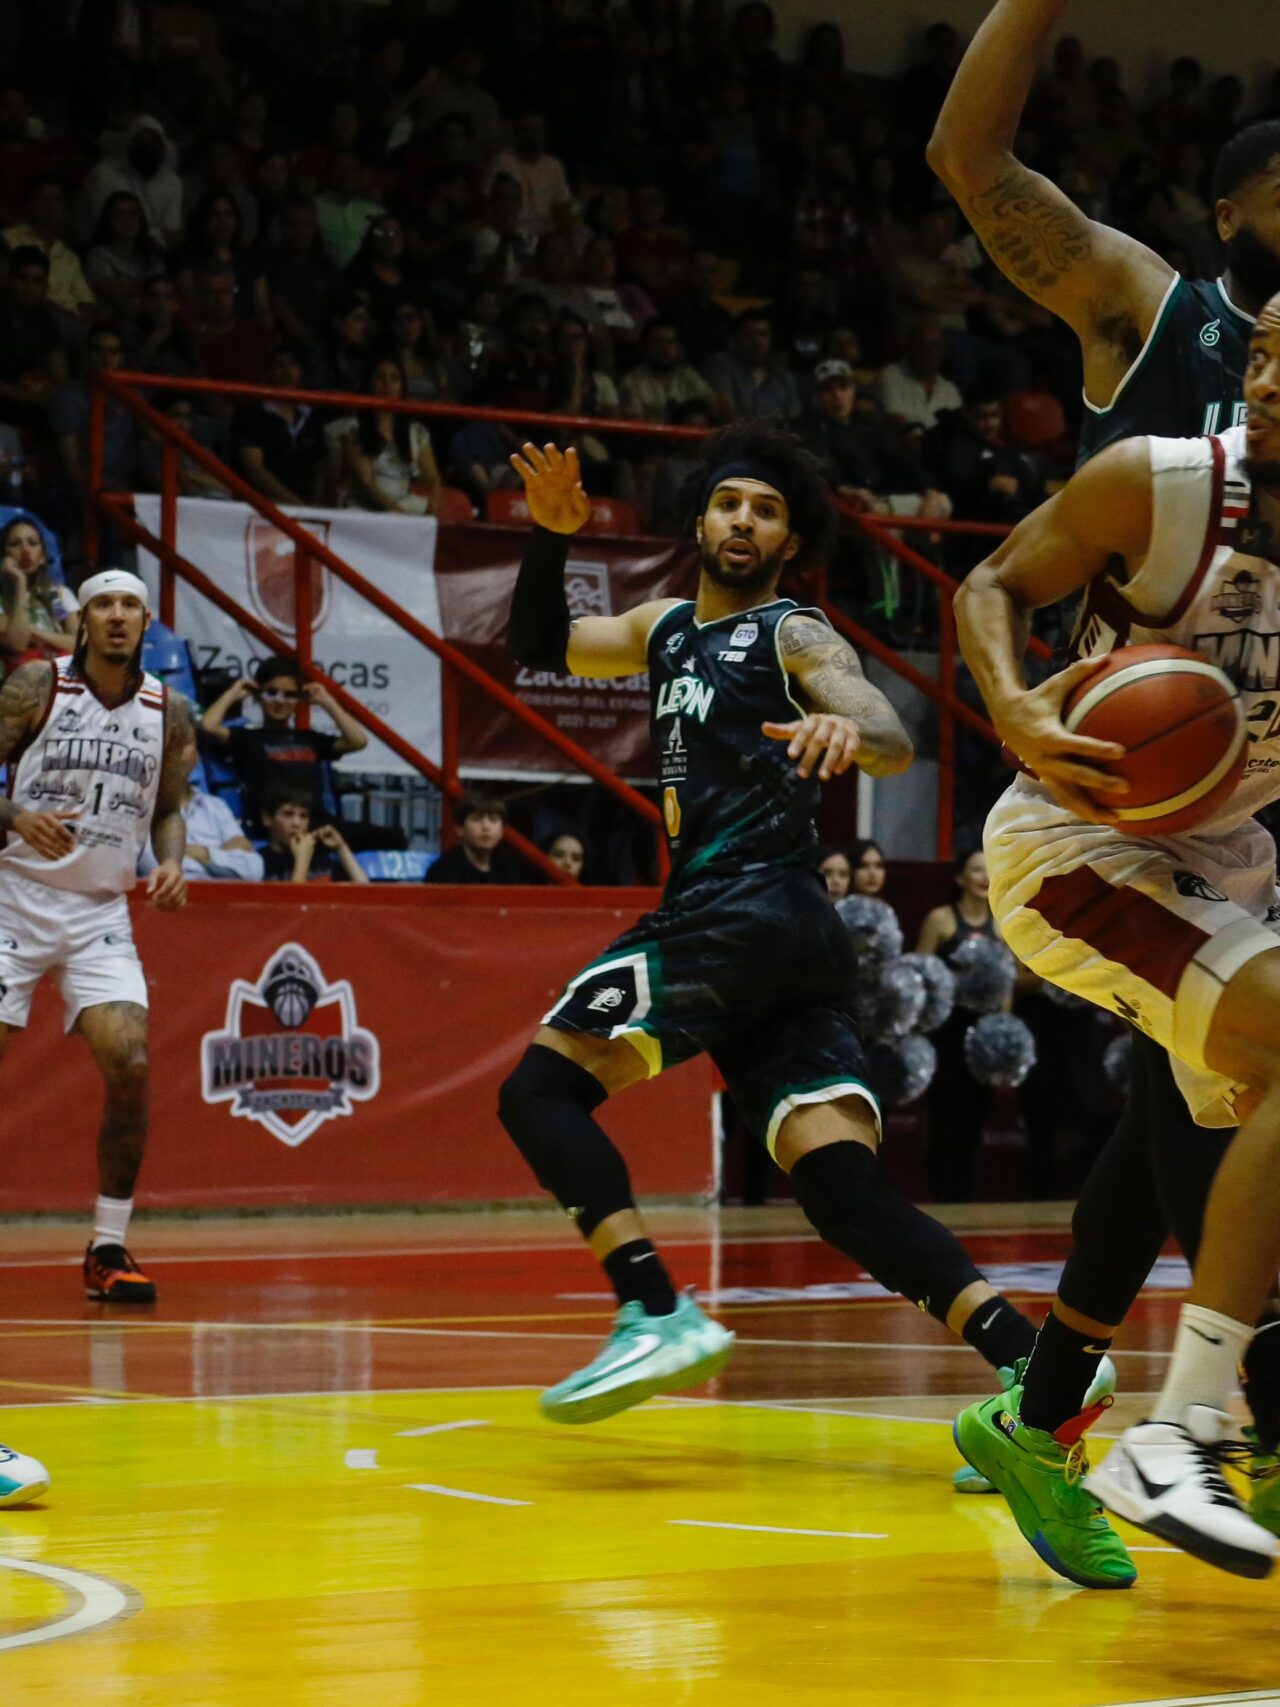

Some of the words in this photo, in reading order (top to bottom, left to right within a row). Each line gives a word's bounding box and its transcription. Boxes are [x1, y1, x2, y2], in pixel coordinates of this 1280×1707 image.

[1200, 319, 1220, 346] 6
[42, 738, 157, 789] MINEROS
[92, 782, 104, 815] 1
[212, 1033, 369, 1087] MINEROS
